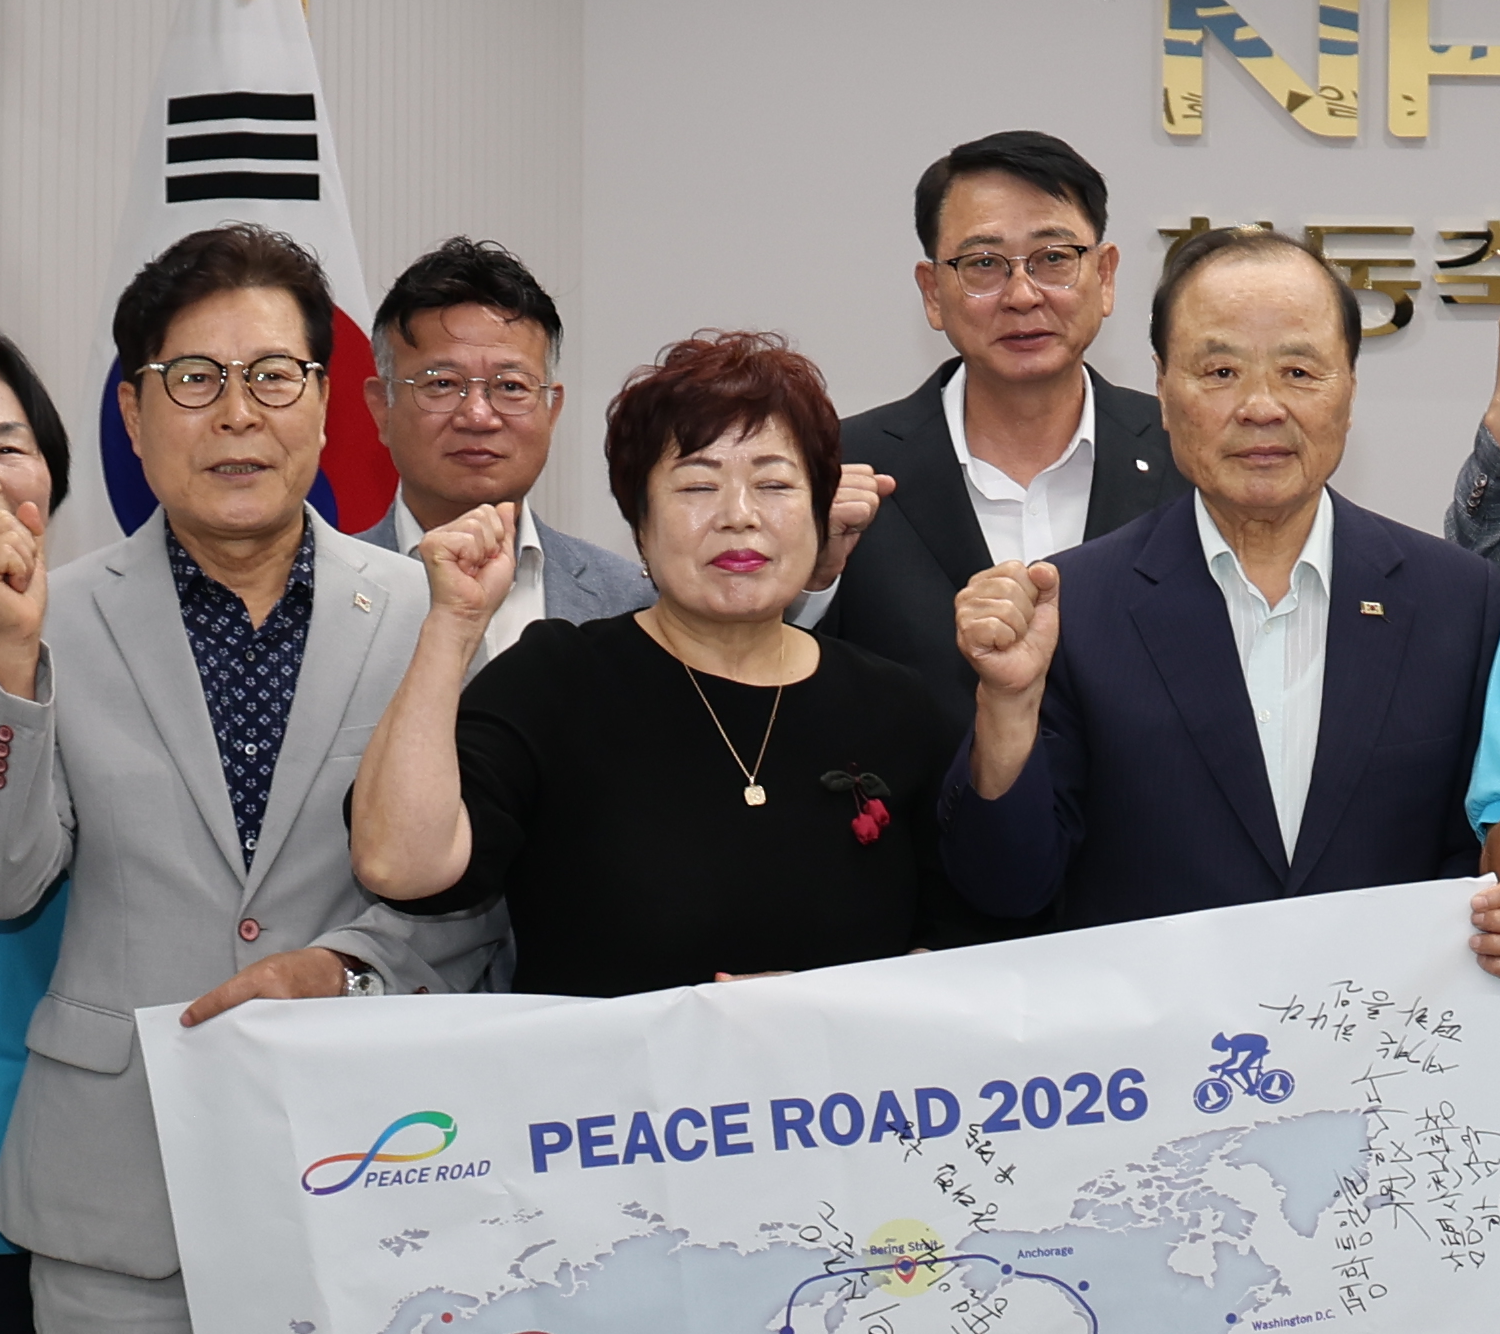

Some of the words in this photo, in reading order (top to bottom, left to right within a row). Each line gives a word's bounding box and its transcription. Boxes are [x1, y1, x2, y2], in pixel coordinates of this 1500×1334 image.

[528, 1101, 755, 1175] PEACE
[769, 1085, 962, 1154] ROAD
[978, 1066, 1150, 1135] 2026
[364, 1165, 431, 1189] PEACE
[434, 1159, 492, 1184] ROAD
[869, 1242, 904, 1256] Bering
[1017, 1245, 1074, 1260] Anchorage
[1252, 1310, 1314, 1331] Washington
